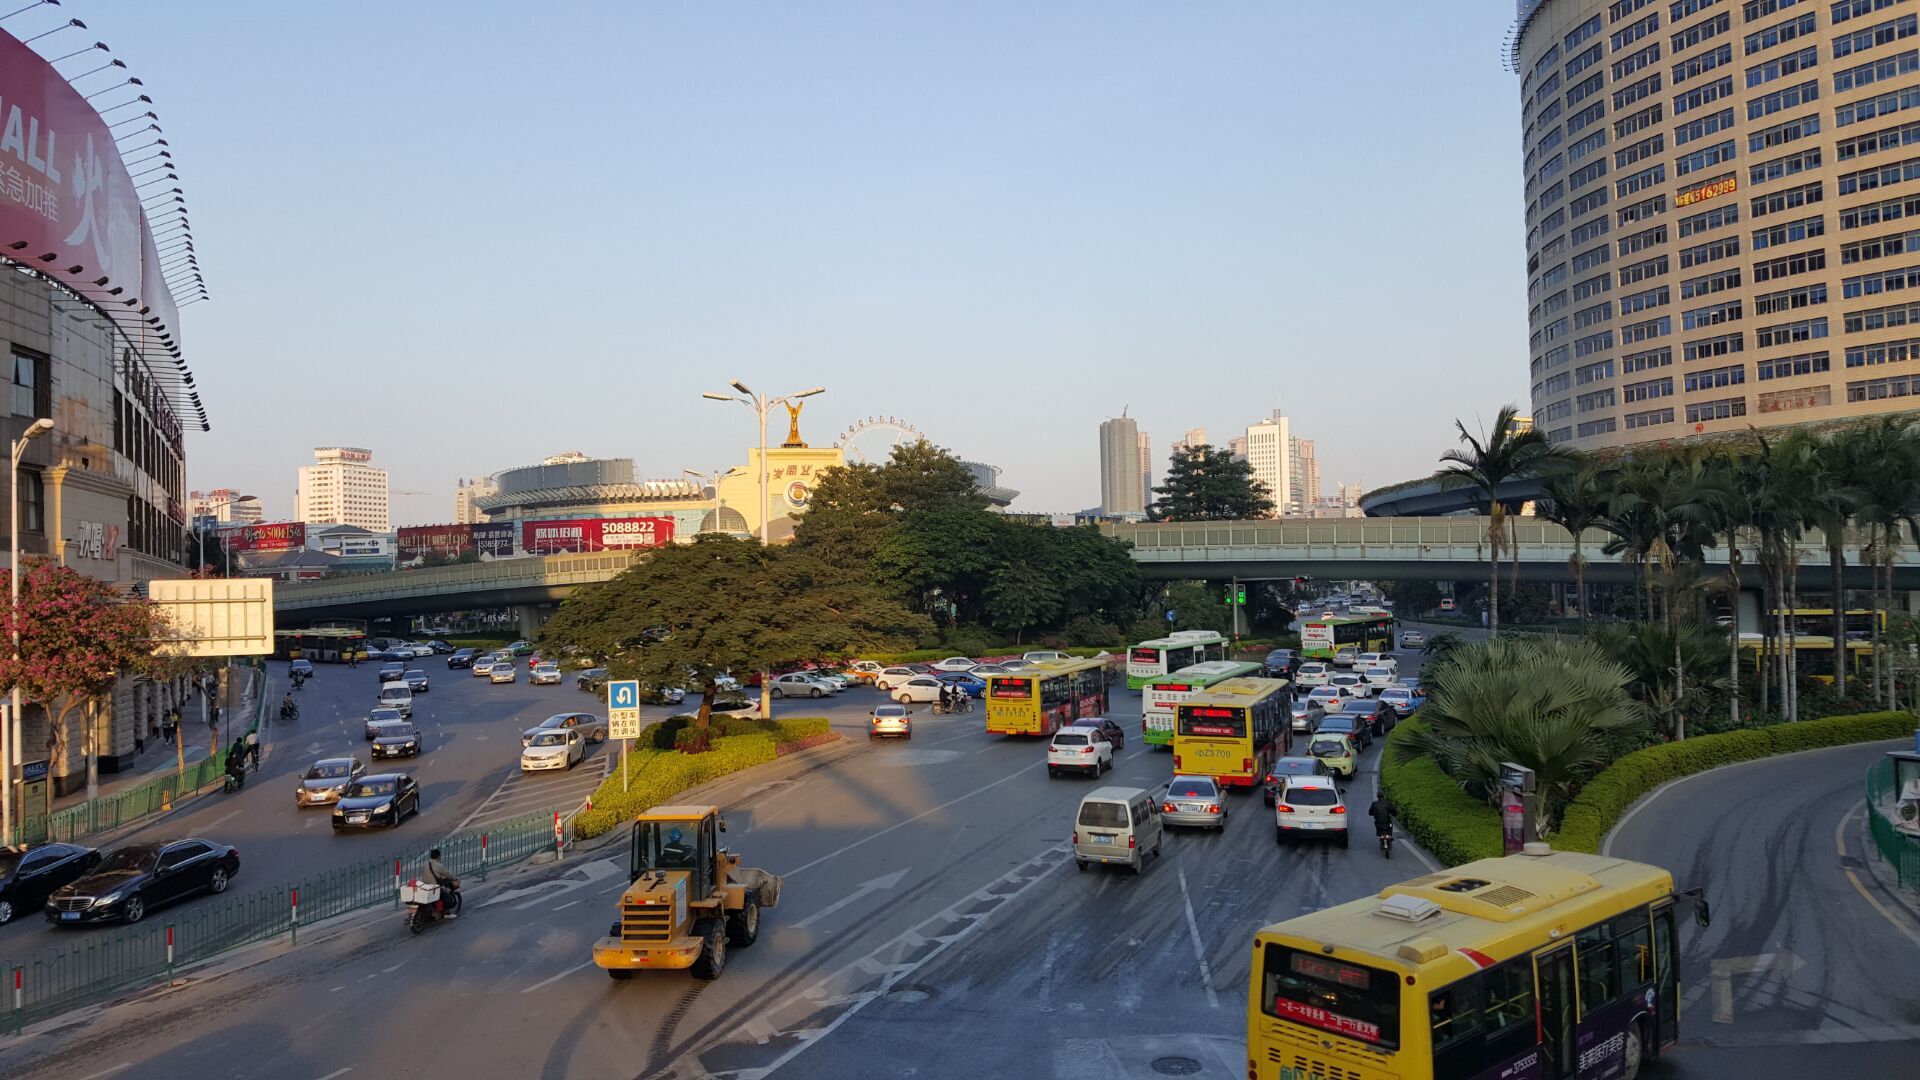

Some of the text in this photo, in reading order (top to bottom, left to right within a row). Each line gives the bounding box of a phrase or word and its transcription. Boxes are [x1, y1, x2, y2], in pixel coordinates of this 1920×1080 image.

[0, 97, 61, 184] ALL
[601, 522, 655, 534] 5088822
[611, 712, 637, 720] 小型车
[611, 719, 637, 728] 辆在前
[611, 727, 637, 735] 方调头
